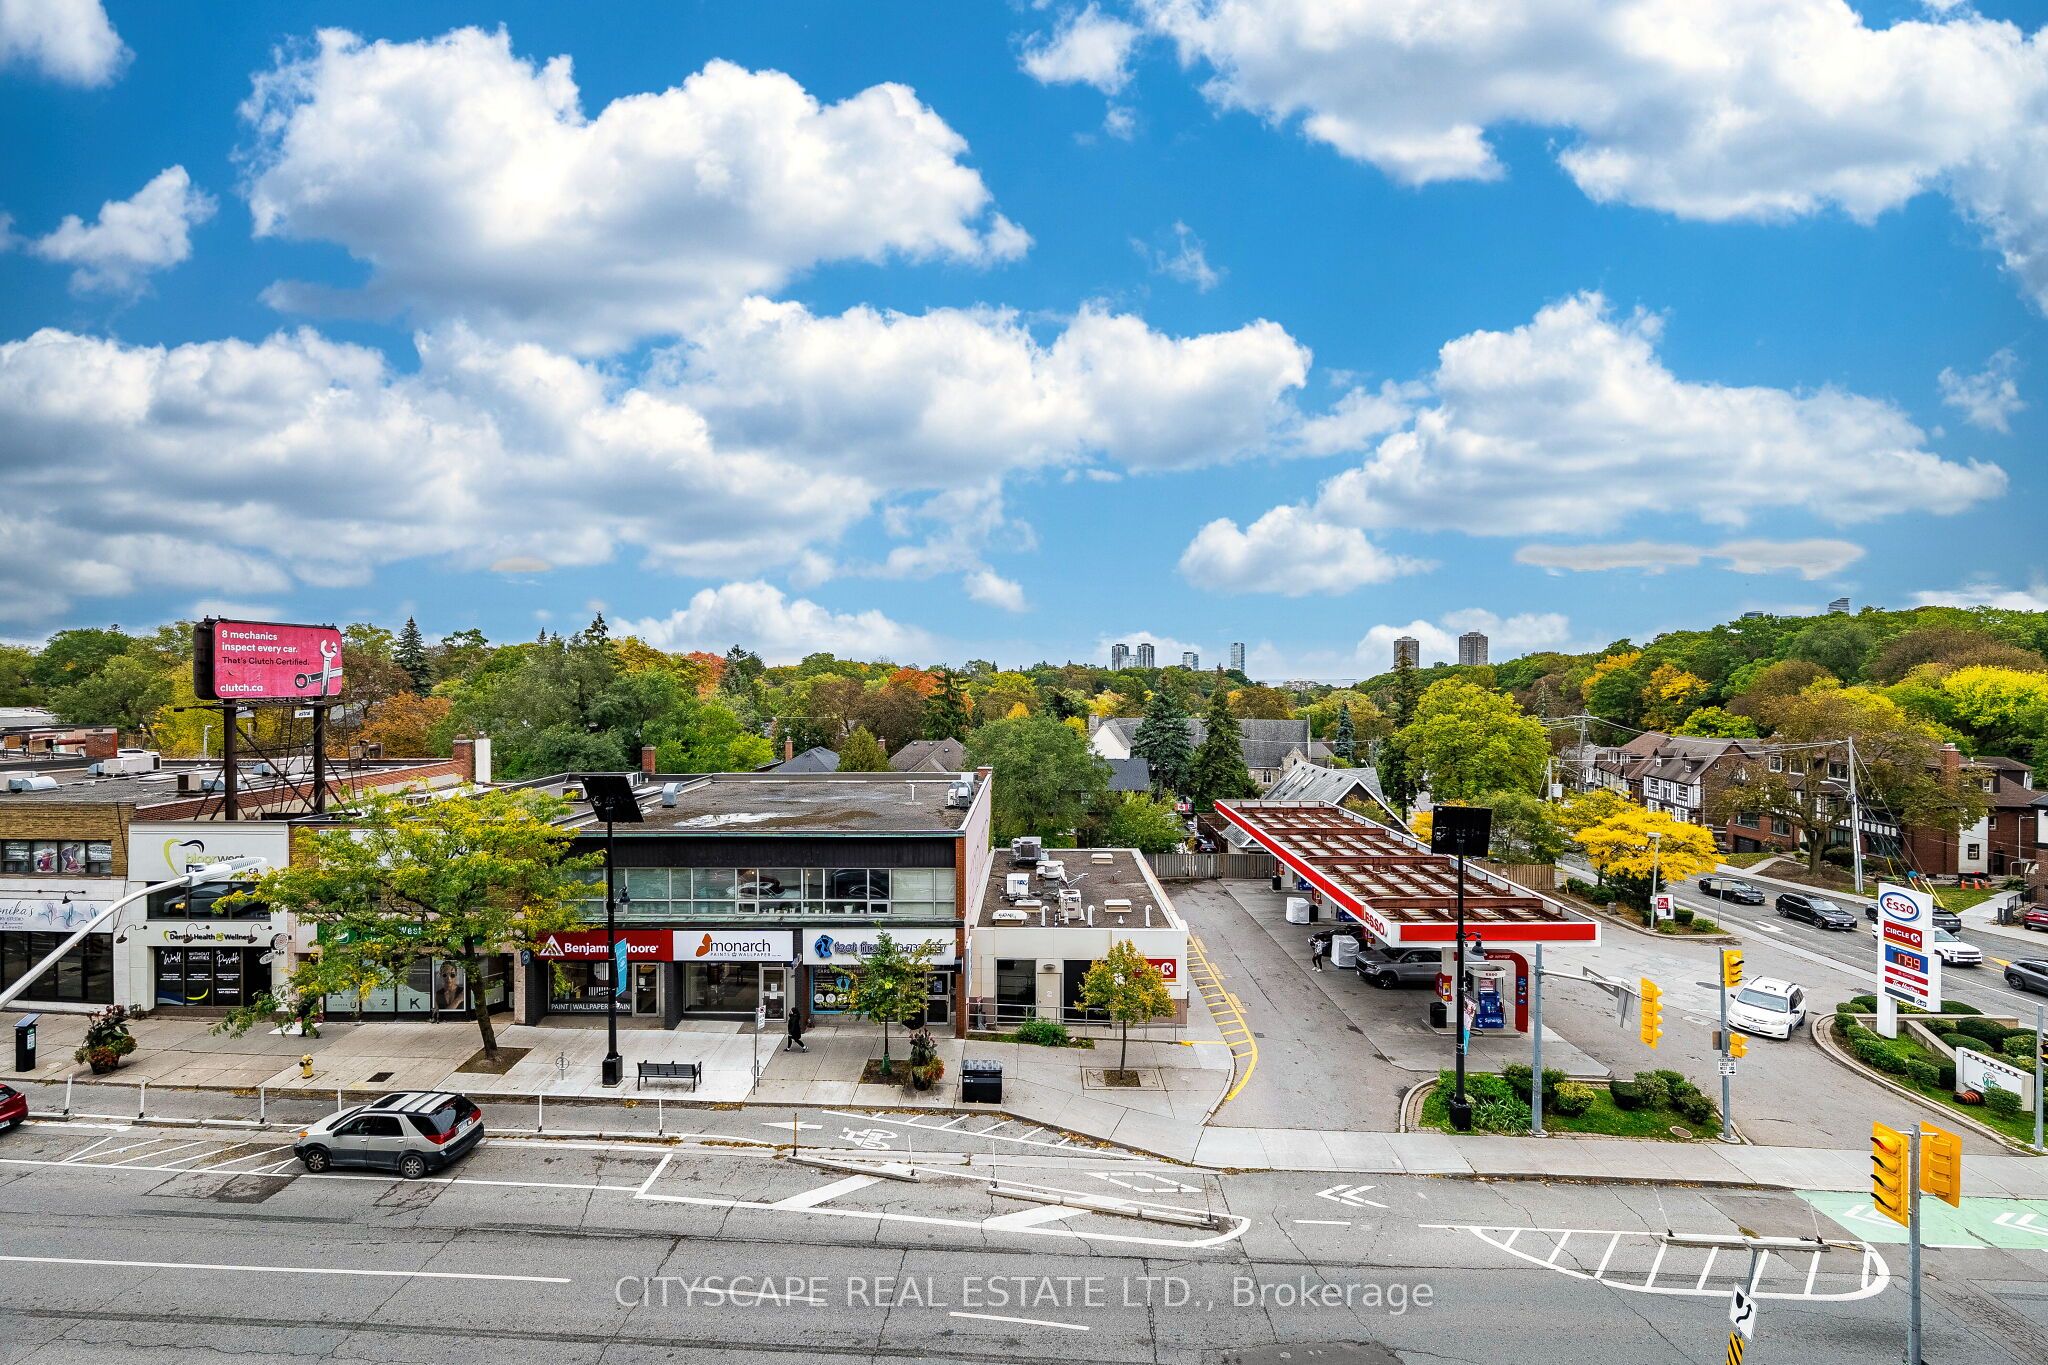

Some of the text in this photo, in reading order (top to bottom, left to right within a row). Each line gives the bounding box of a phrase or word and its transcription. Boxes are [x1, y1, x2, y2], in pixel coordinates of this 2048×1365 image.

[222, 630, 278, 640] 8 mechanics
[222, 642, 255, 652] inspect
[257, 644, 281, 654] every
[222, 656, 310, 666] That's Clutch Certified.
[220, 683, 263, 692] clutch.ca
[399, 926, 422, 935] West
[1885, 927, 1910, 939] CIRCLE
[193, 933, 215, 941] Health
[710, 939, 771, 952] monarch
